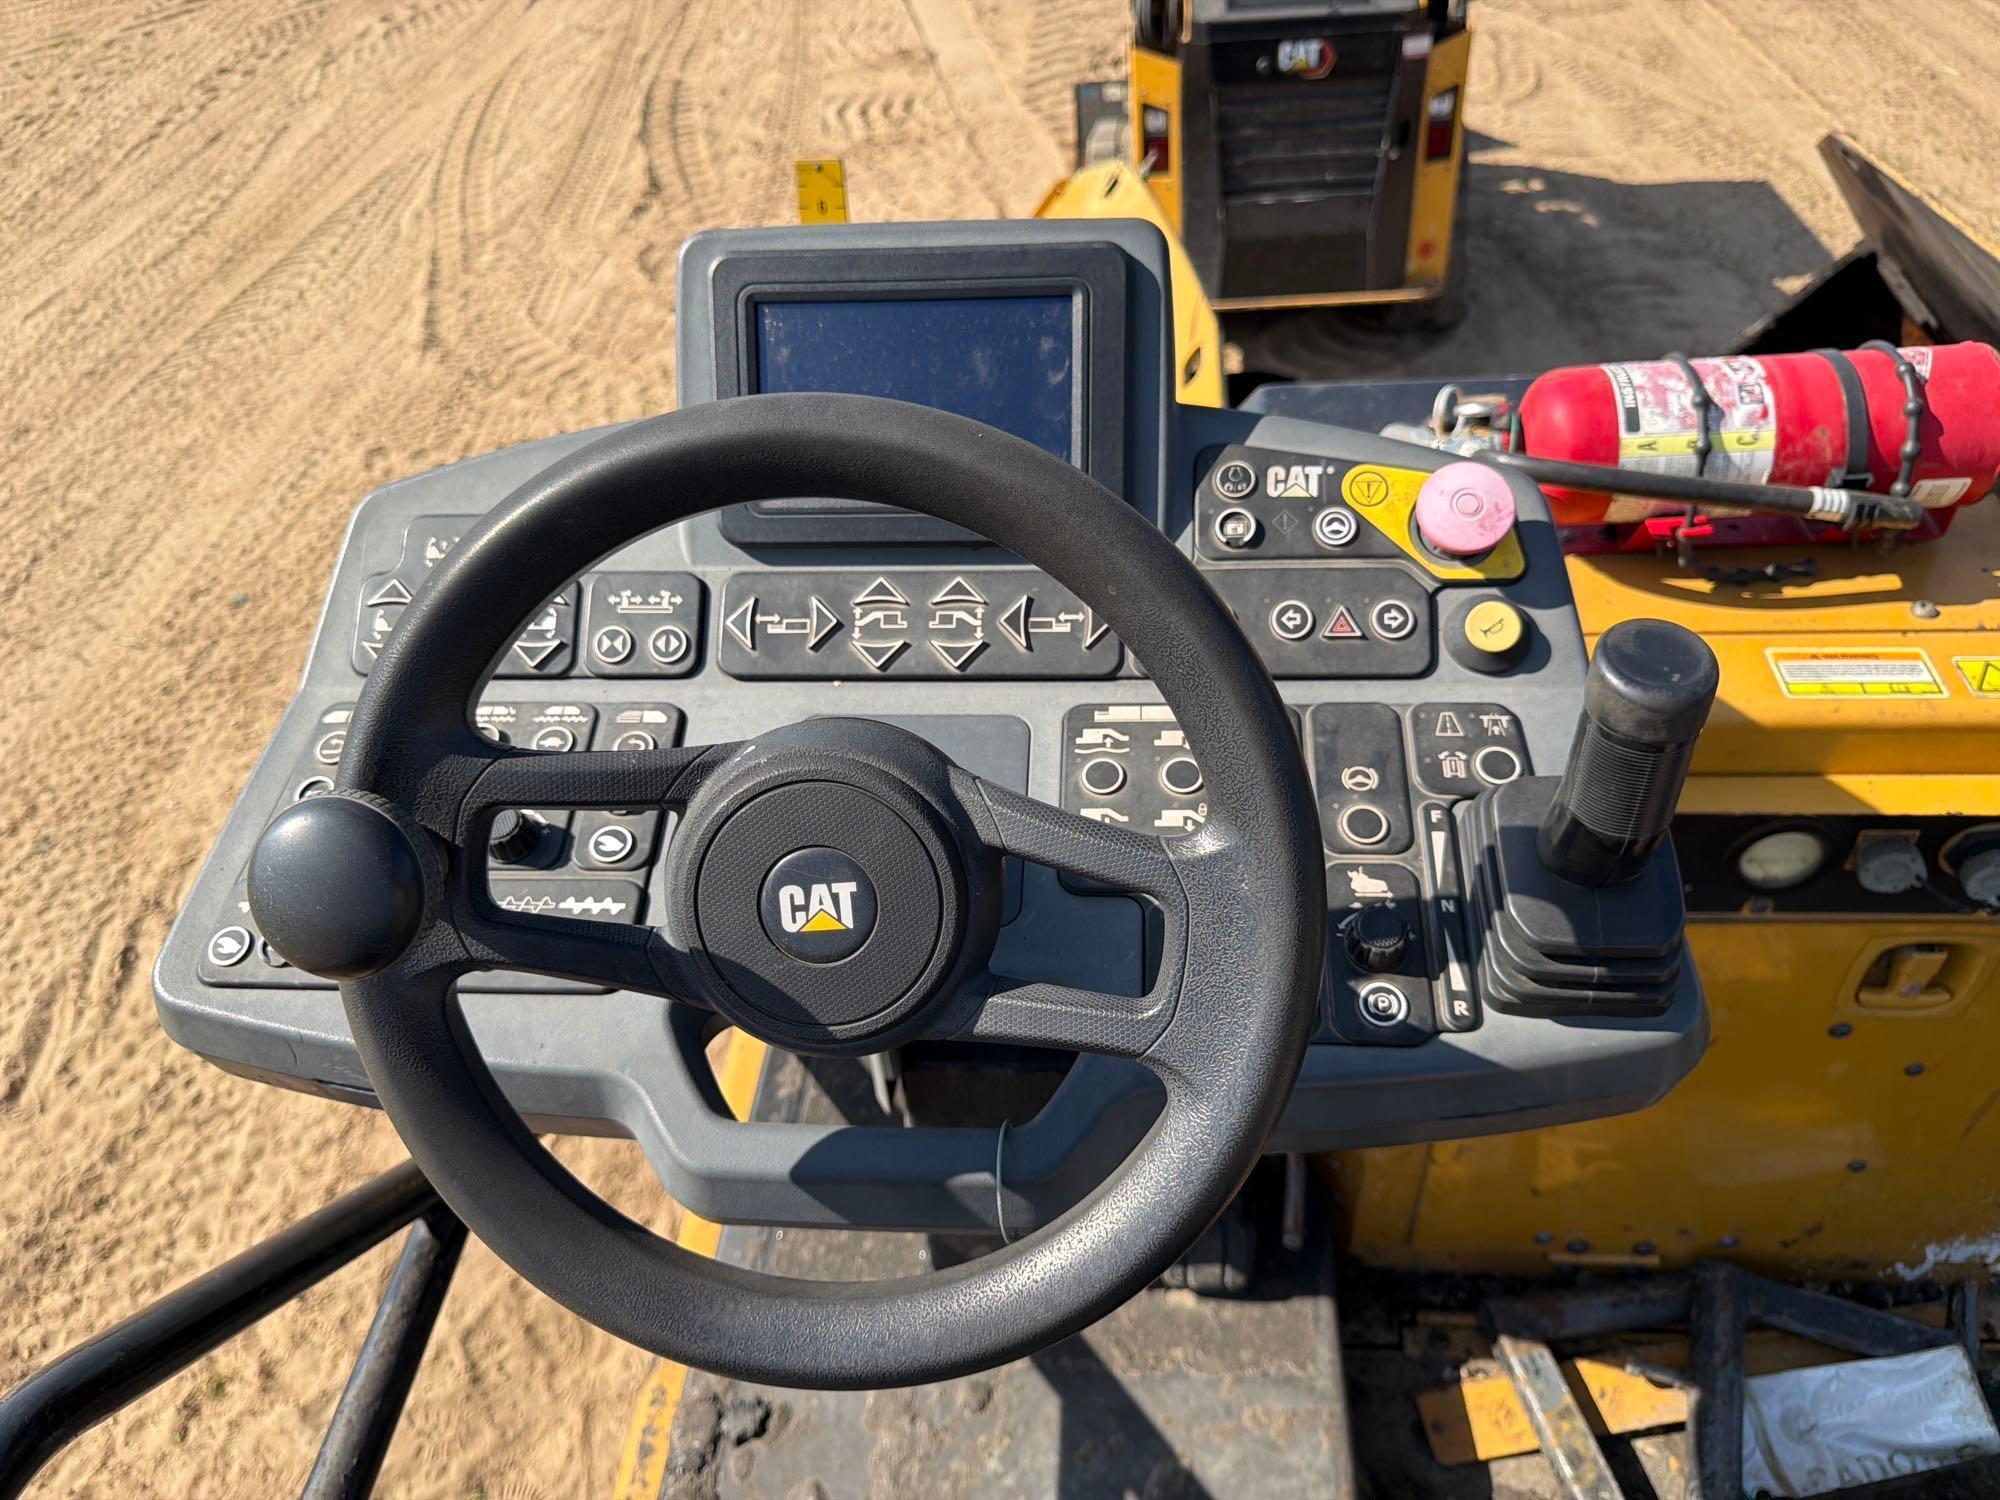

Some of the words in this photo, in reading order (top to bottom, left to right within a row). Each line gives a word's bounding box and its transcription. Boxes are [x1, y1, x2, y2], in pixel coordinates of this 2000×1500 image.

[1278, 39, 1323, 71] CAT
[1266, 465, 1323, 498] CAT
[1430, 810, 1443, 824] F
[778, 881, 857, 933] CAT
[1441, 900, 1455, 912] N
[1453, 1000, 1470, 1016] R
